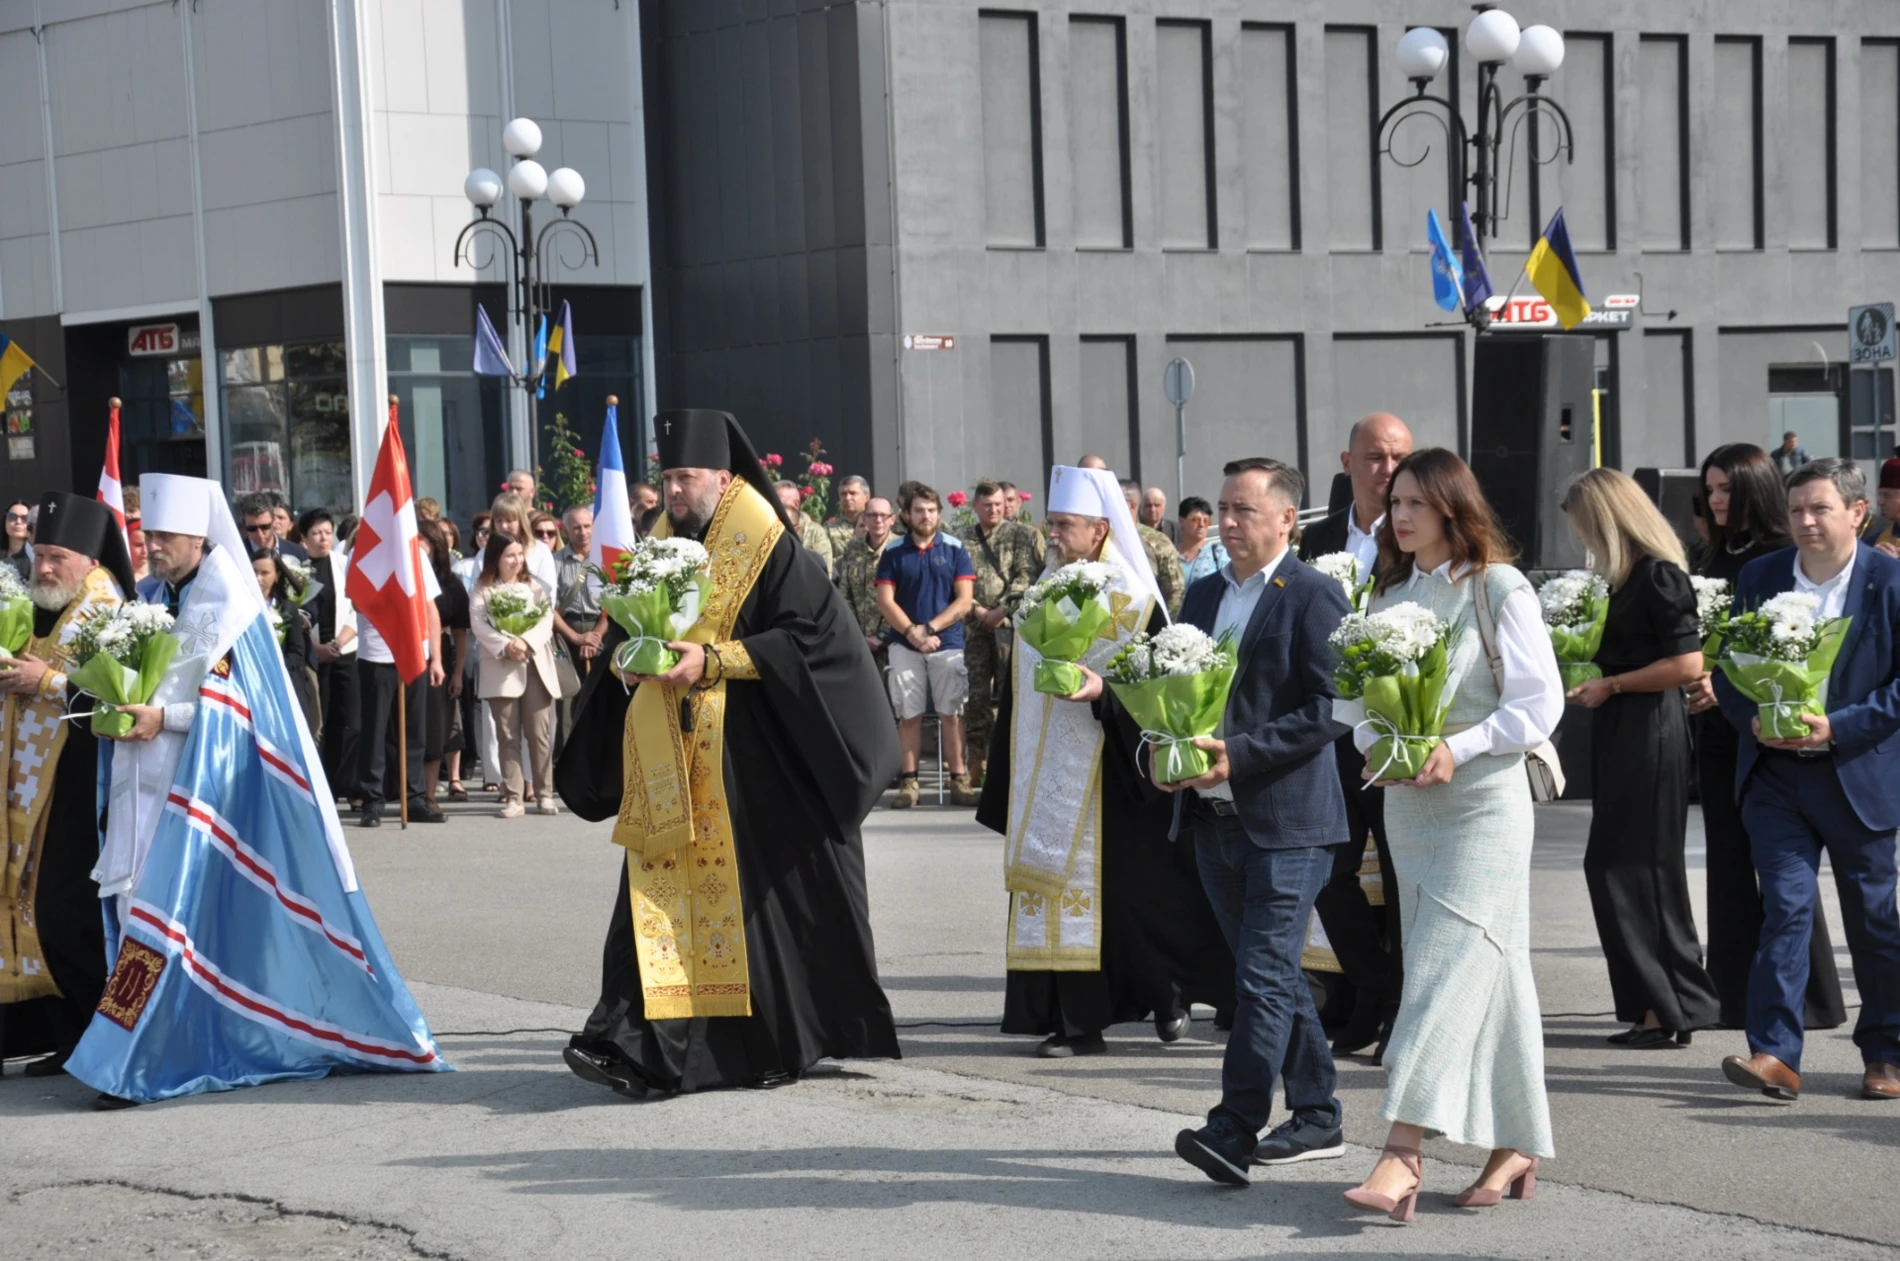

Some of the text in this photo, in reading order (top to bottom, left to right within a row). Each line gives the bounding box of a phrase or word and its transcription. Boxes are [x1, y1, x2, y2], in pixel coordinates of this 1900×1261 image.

[1490, 300, 1550, 323] АТБ
[130, 326, 175, 352] АТБ
[1854, 345, 1892, 361] ЗОНА
